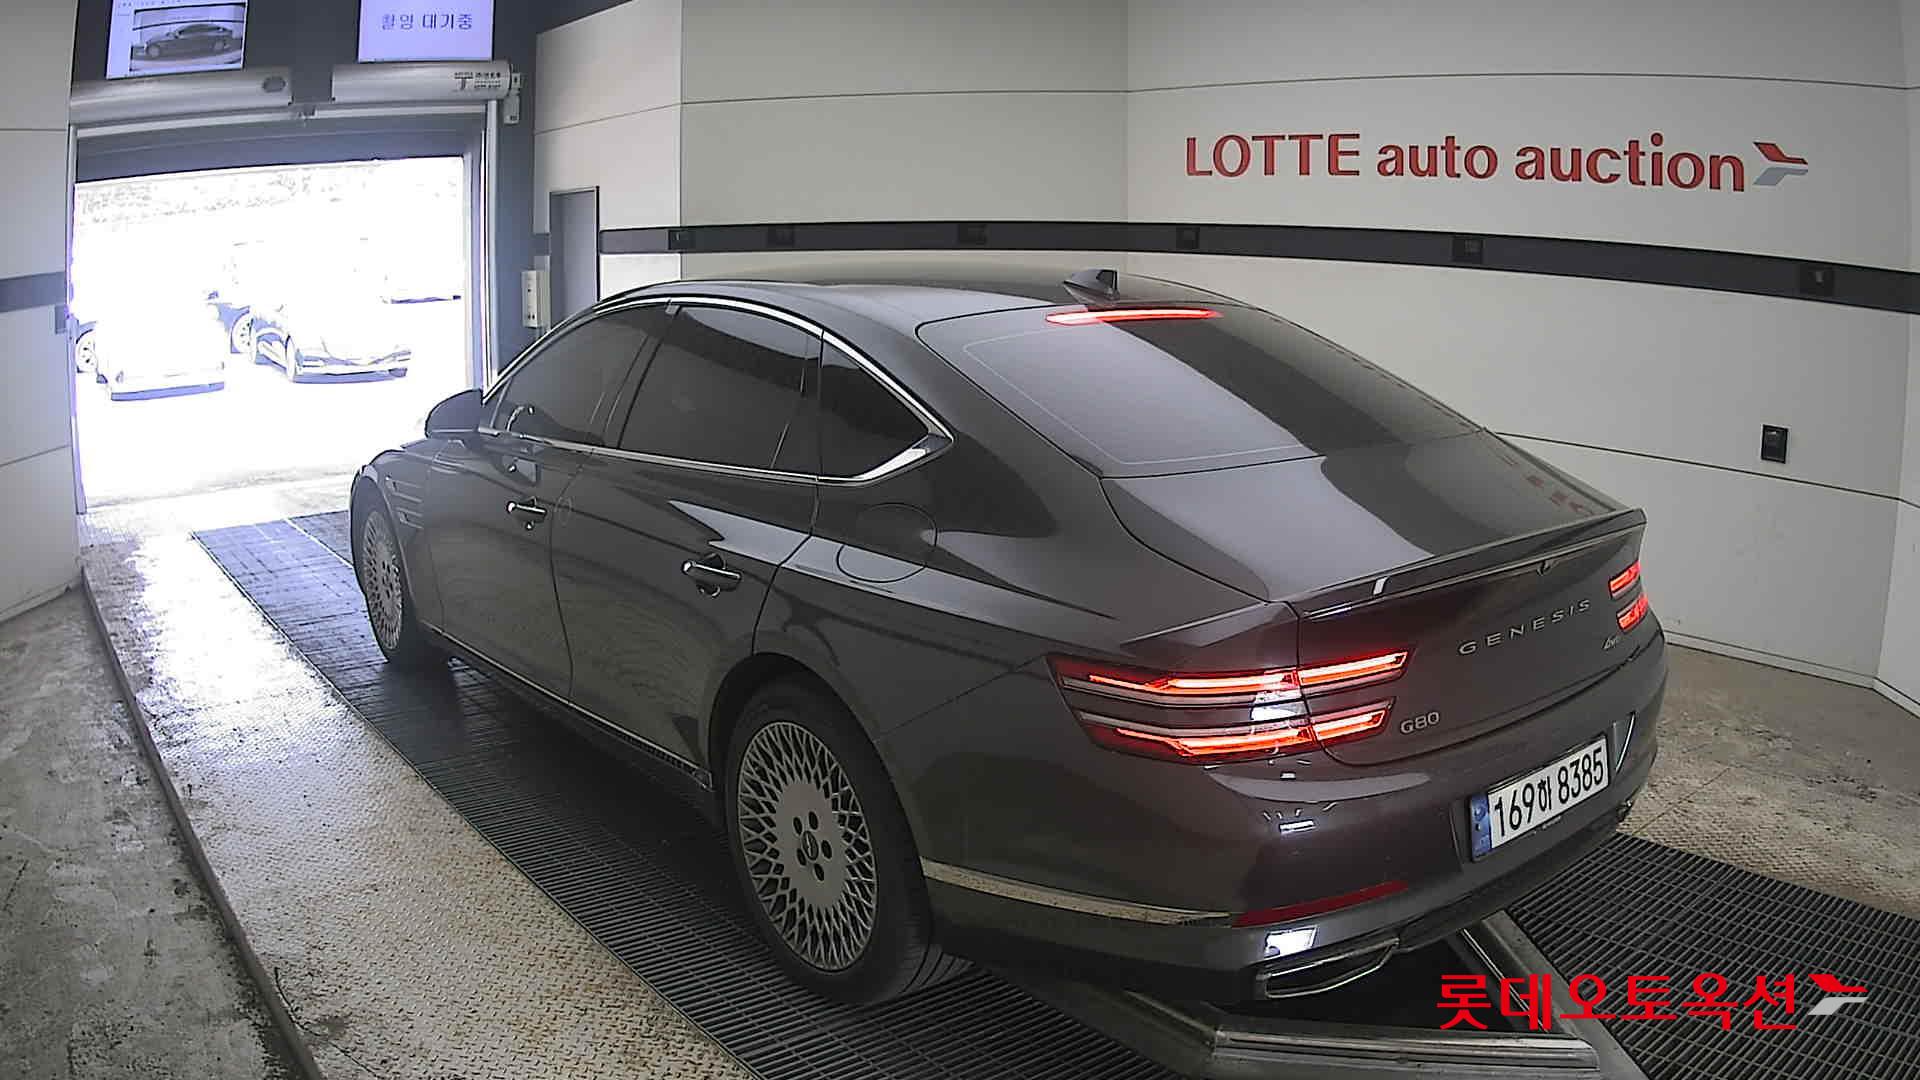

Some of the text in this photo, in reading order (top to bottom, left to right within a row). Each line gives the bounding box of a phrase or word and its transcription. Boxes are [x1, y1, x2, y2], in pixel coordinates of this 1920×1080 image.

[422, 13, 473, 30] 대기중
[1186, 132, 1745, 192] LOTTE auto auction
[1458, 599, 1591, 656] GENESIS
[1400, 710, 1441, 735] G80
[1557, 746, 1604, 805] 8385
